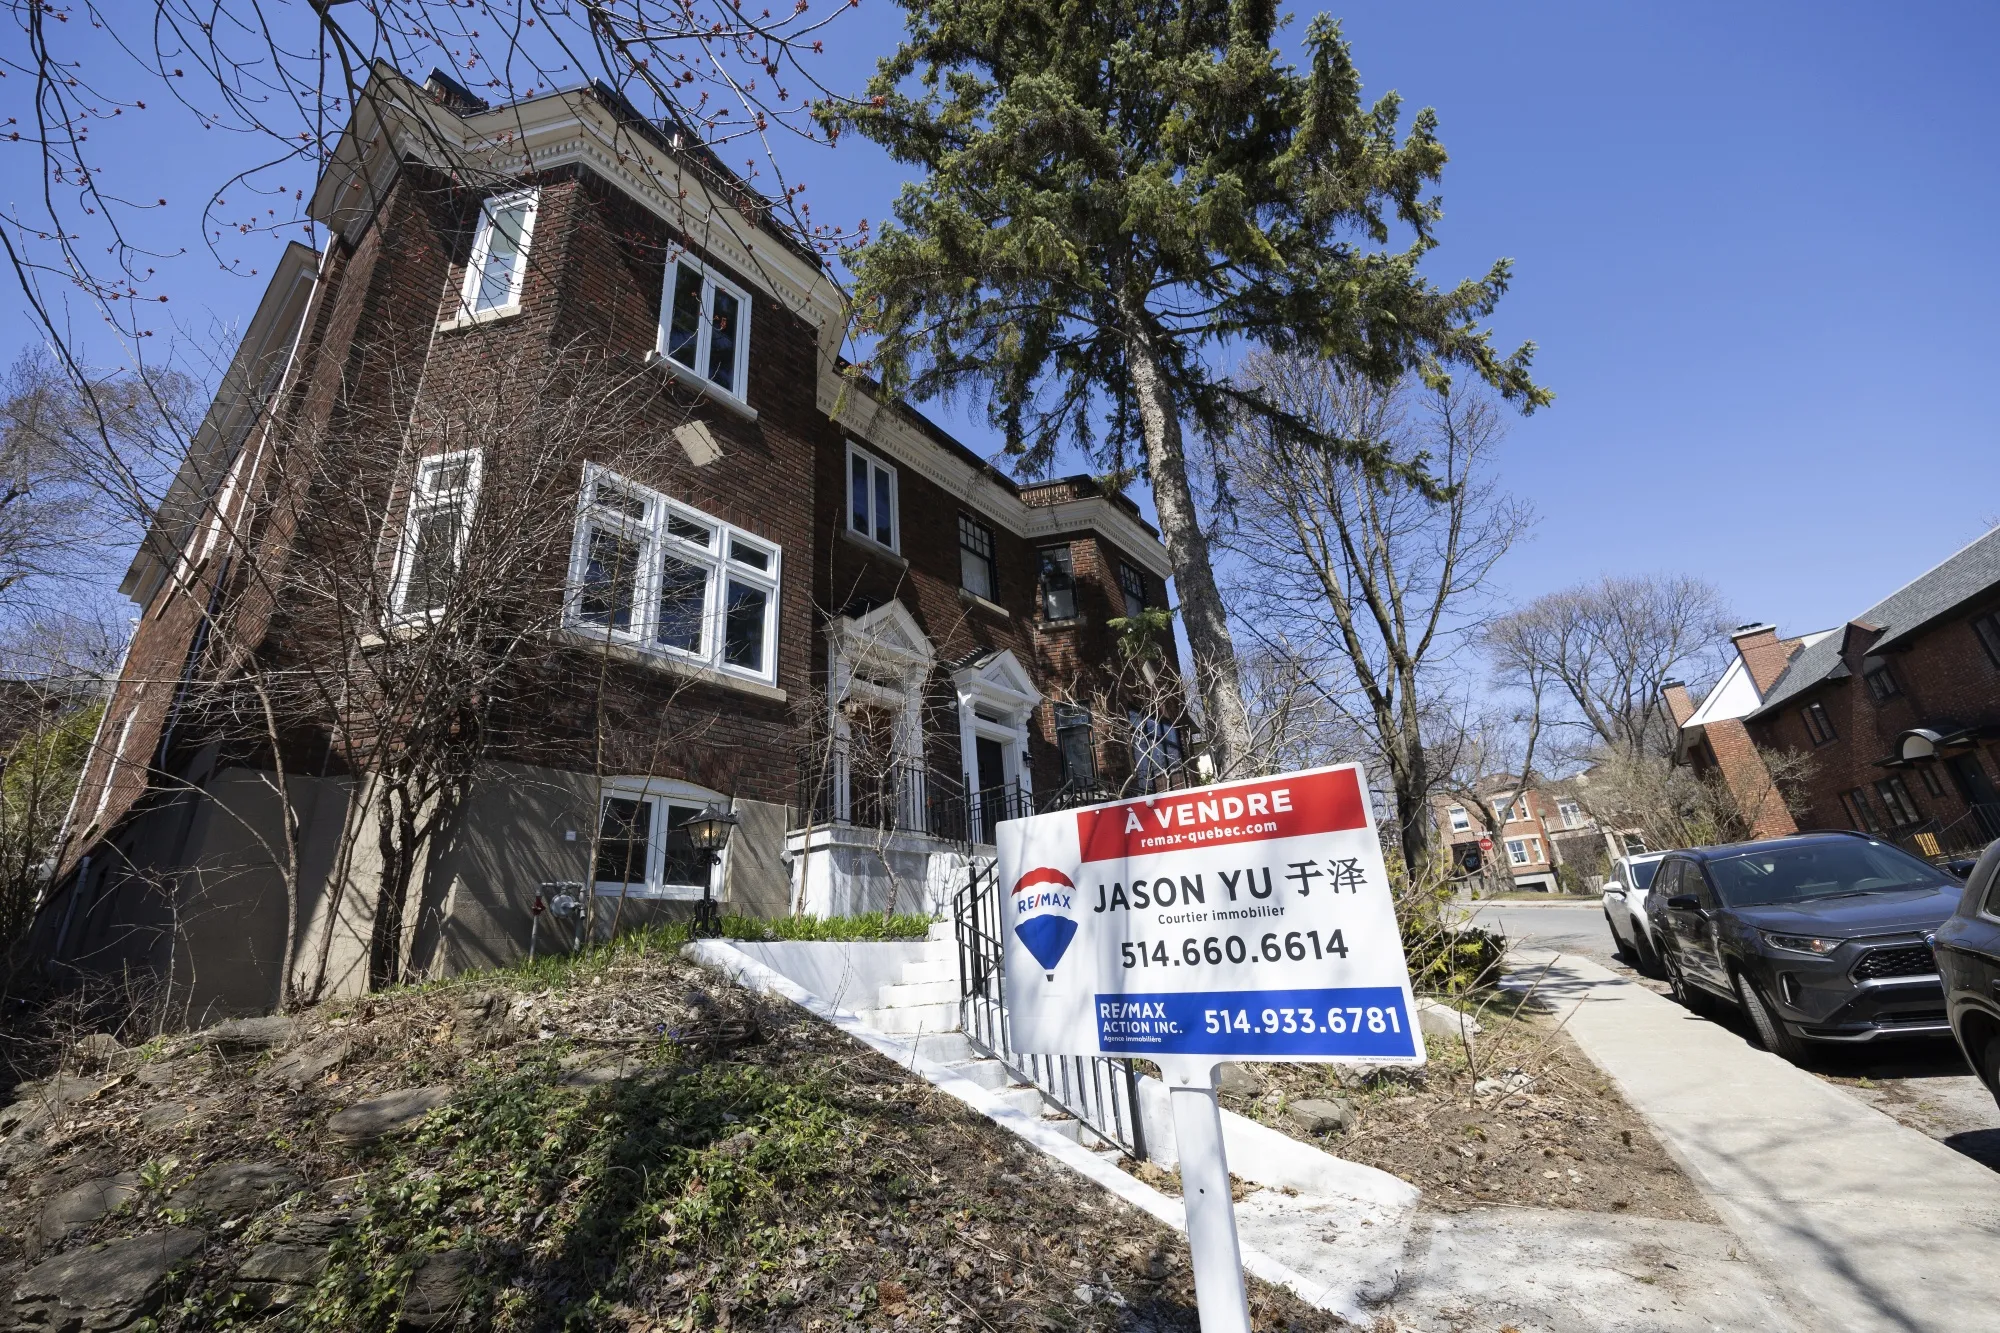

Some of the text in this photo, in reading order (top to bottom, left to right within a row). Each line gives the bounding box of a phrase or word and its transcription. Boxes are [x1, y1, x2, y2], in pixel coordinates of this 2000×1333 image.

[1124, 788, 1294, 834] À VENDRE
[1141, 821, 1278, 848] remax-quebec.com
[1093, 873, 1206, 914] JASON
[1217, 866, 1273, 901] YU
[1018, 893, 1071, 914] RE/MAX
[1158, 905, 1286, 925] Courtier immobilier
[1121, 928, 1349, 969] 514.660.6614
[1100, 1002, 1167, 1019] RE/MAX
[1204, 1006, 1401, 1034] 514.933.6781
[1103, 1021, 1183, 1034] ACTION INC.
[1103, 1035, 1162, 1043] Agence immobilière
